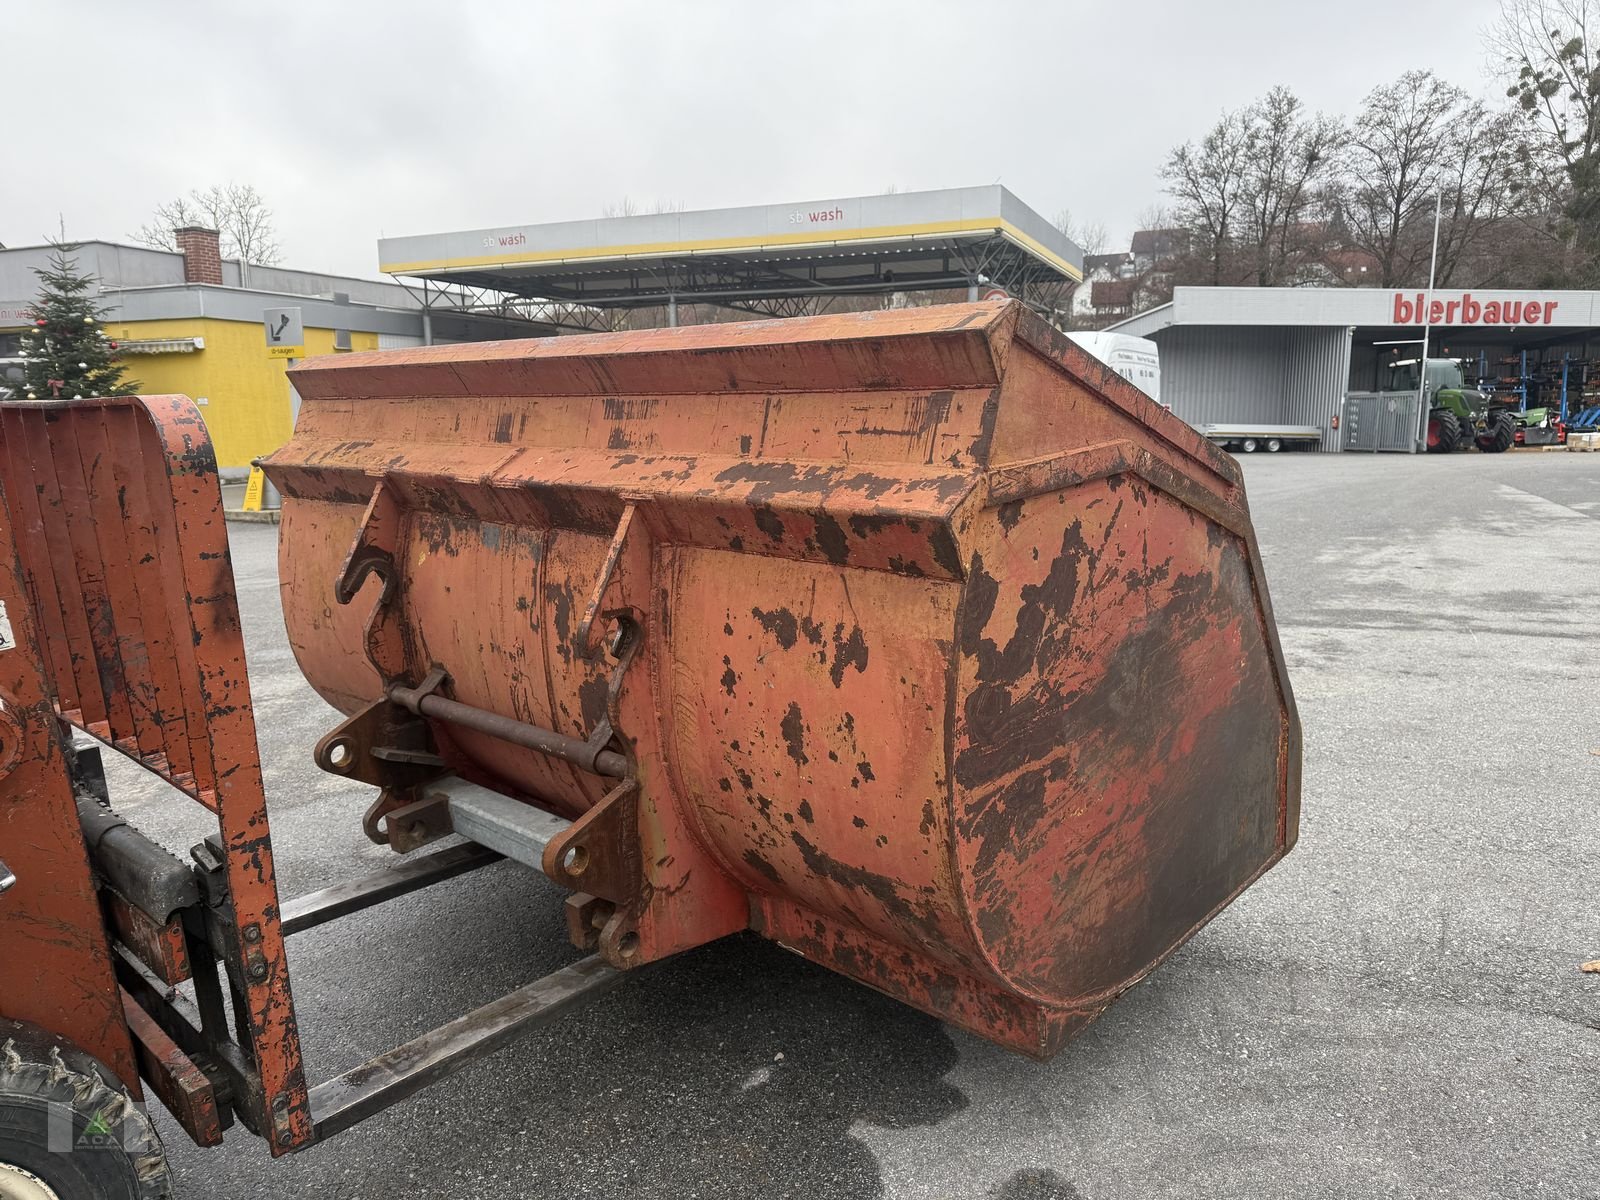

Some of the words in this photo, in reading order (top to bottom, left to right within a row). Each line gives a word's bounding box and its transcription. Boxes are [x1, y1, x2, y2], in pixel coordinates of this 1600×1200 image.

[808, 206, 843, 222] wash
[498, 232, 526, 247] wash
[1393, 293, 1558, 324] bierbauer
